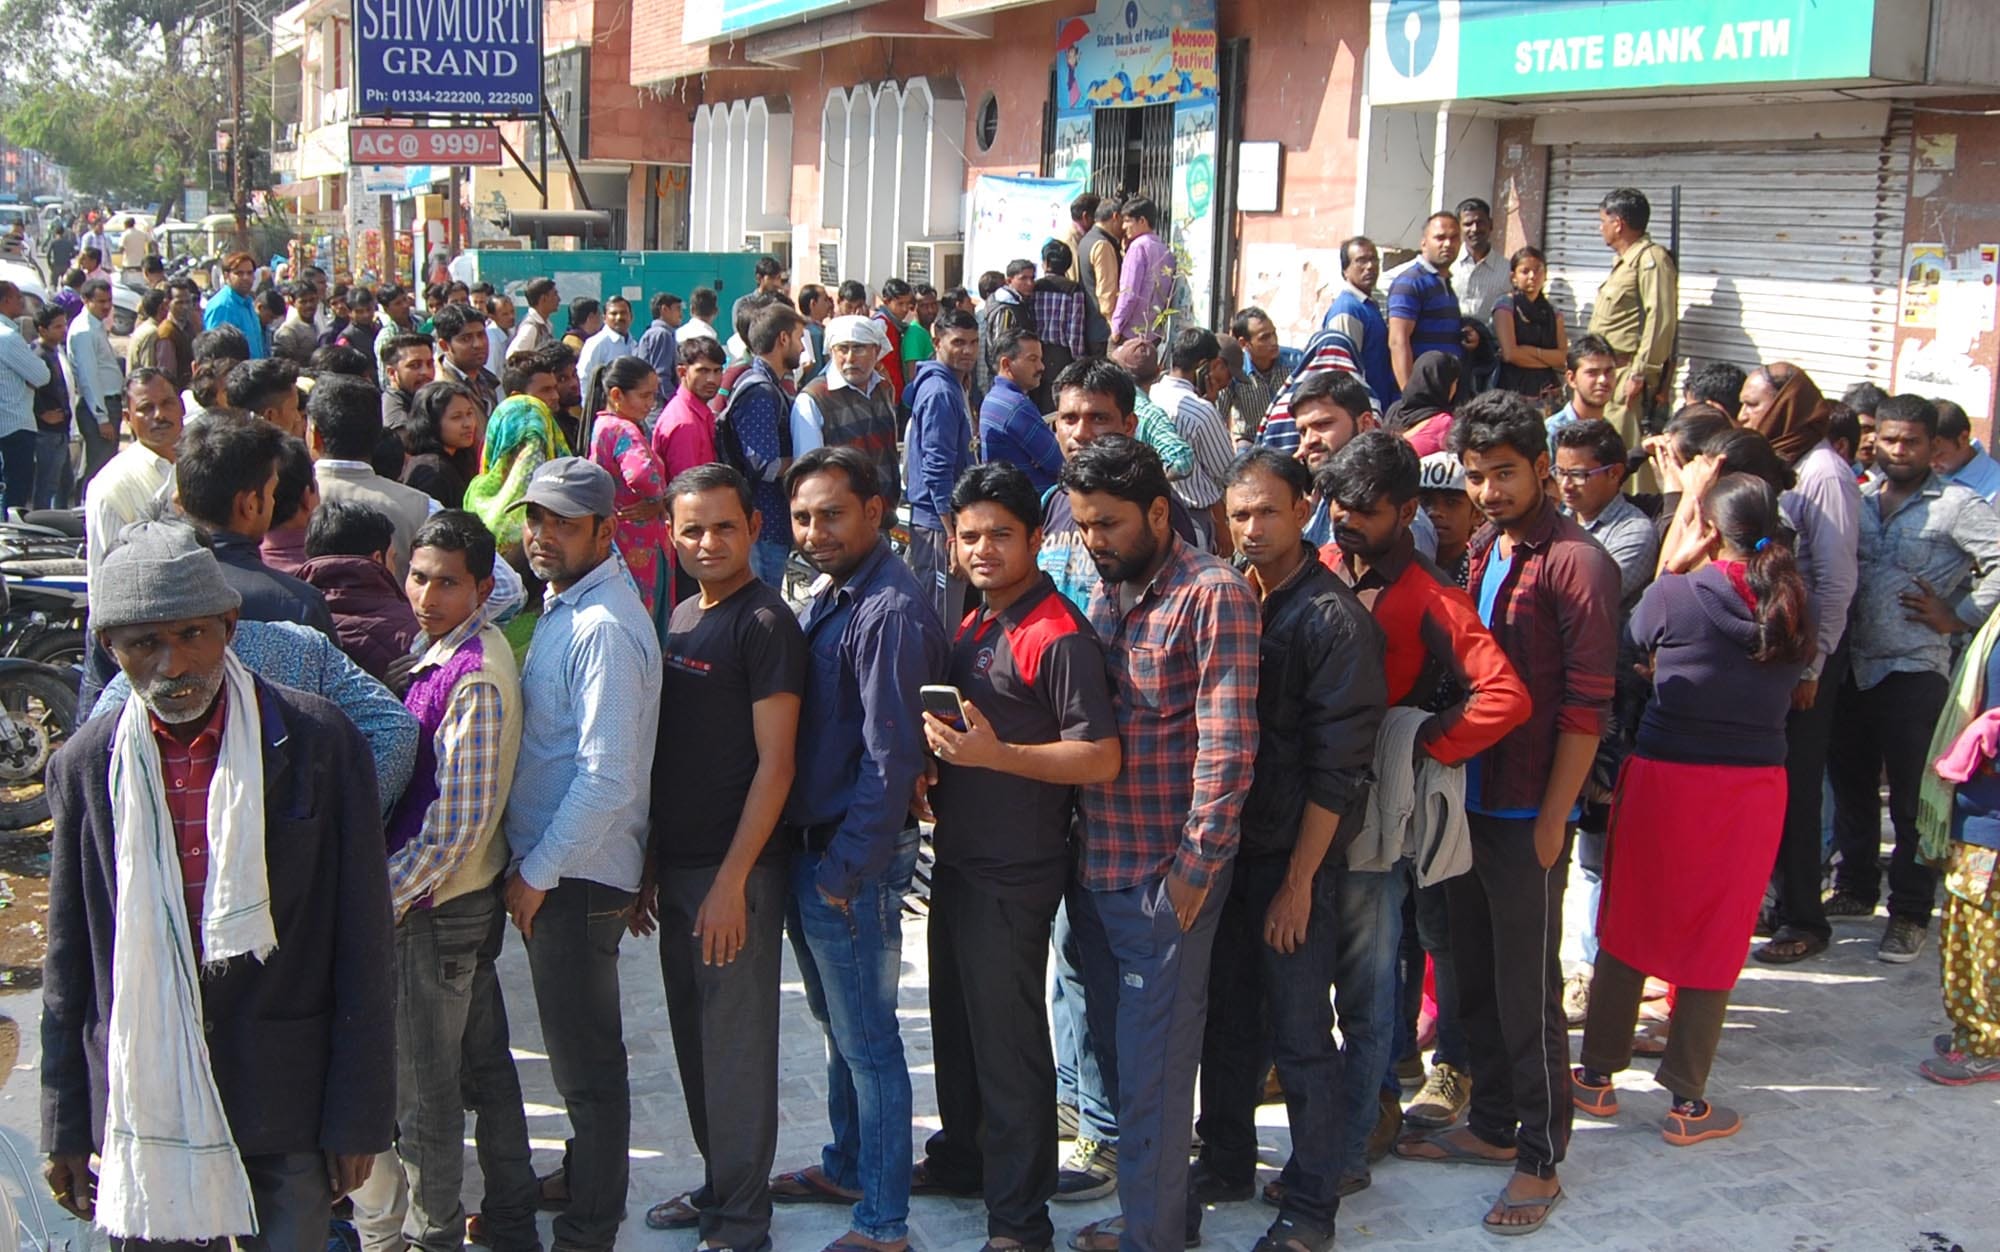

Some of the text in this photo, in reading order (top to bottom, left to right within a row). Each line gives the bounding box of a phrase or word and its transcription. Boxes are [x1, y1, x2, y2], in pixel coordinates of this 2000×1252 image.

[363, 0, 535, 44] SHIVMURTI
[1096, 33, 1114, 48] State
[1115, 31, 1133, 46] Bank
[1135, 28, 1143, 43] of
[1515, 18, 1791, 75] STATE BANK ATM
[382, 47, 518, 76] GRAND
[366, 89, 388, 102] Ph:
[488, 92, 533, 105] 222500
[430, 133, 495, 154] 999/-
